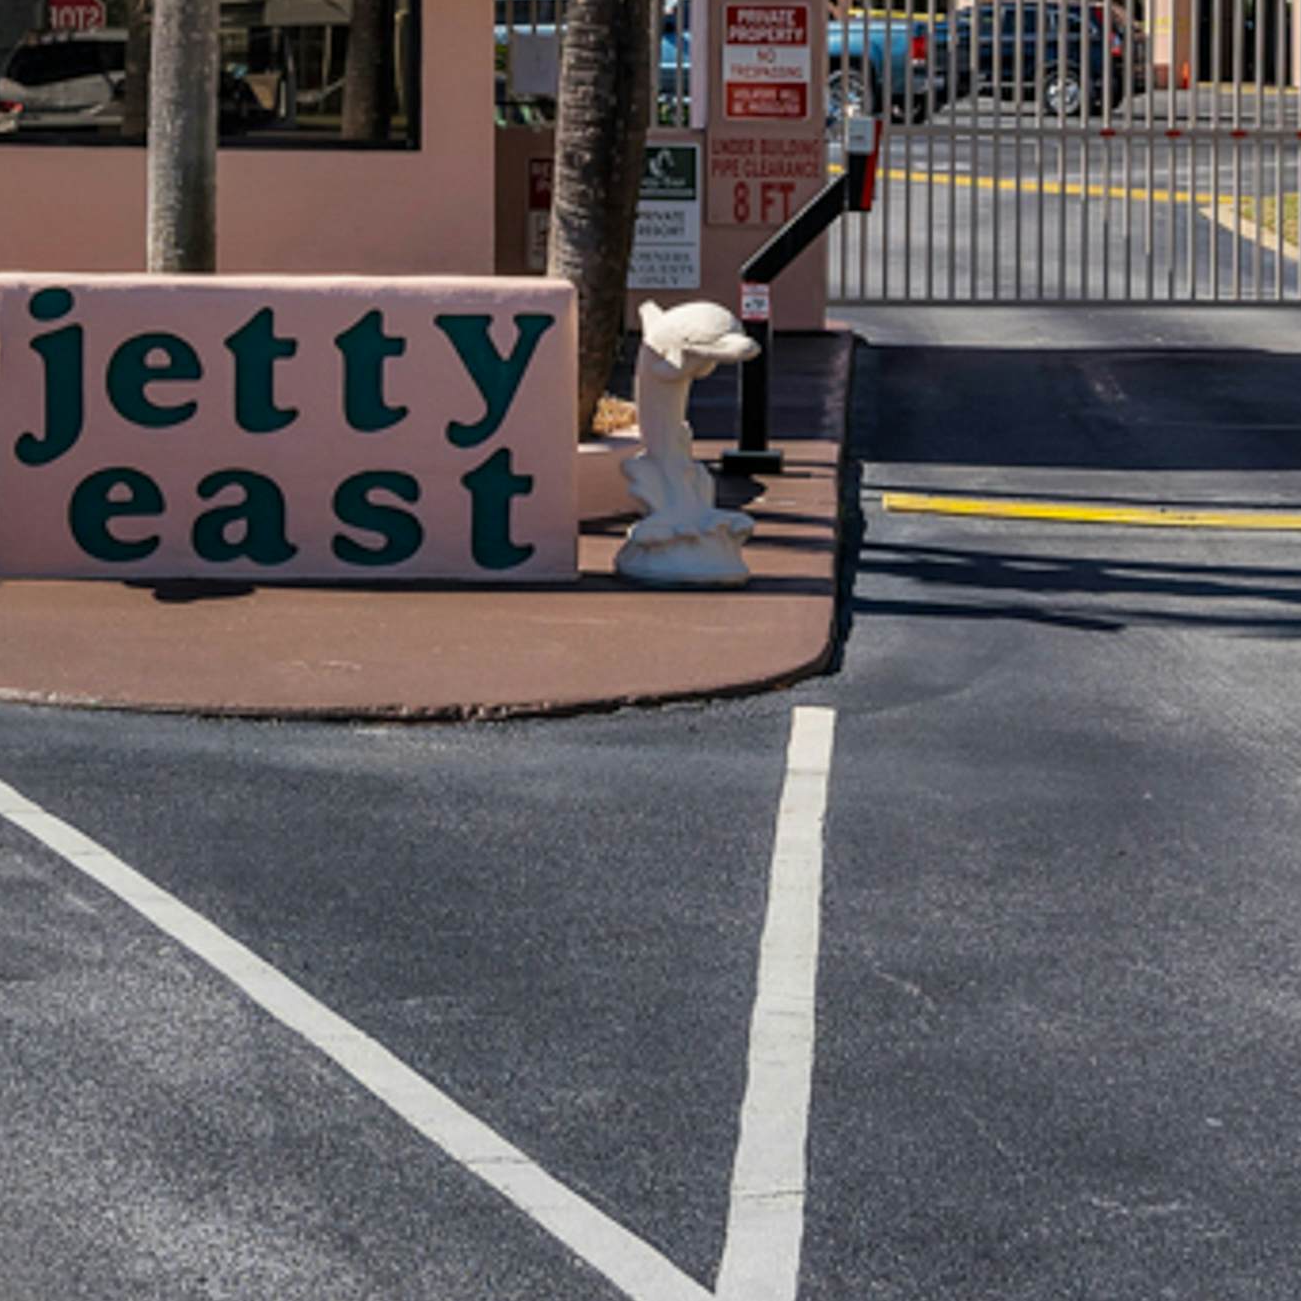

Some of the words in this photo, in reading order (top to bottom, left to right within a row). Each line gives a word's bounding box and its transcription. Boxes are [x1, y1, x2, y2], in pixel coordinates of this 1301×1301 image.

[737, 9, 797, 27] PRIVATE
[729, 25, 805, 42] PROPERTY
[756, 47, 777, 63] NO
[712, 138, 754, 156] UNDER
[760, 138, 819, 158] BUILDING
[711, 158, 739, 178] PIPE
[744, 158, 820, 178] CLEARANCE
[733, 181, 750, 223] 8
[760, 181, 796, 223] FT
[13, 287, 556, 468] jetty
[66, 446, 537, 572] east
